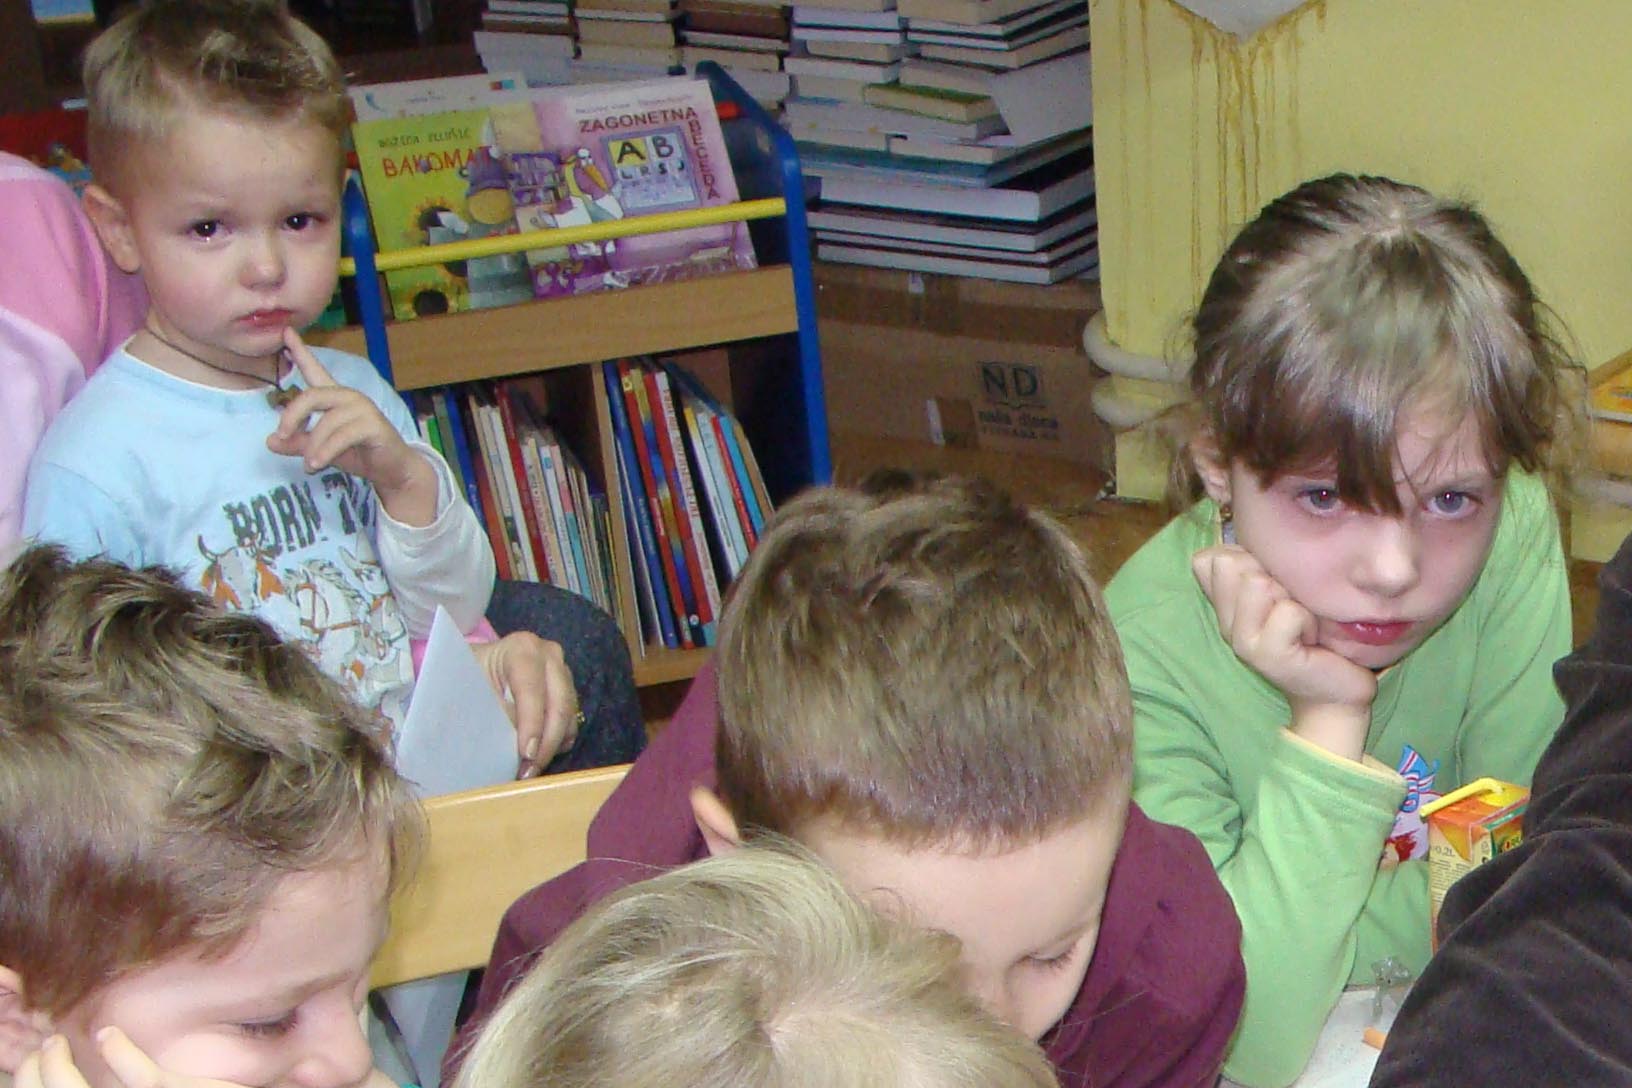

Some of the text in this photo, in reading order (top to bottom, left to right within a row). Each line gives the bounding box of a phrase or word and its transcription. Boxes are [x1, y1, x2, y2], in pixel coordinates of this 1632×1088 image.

[579, 107, 698, 133] ZAGONETNA
[617, 136, 674, 164] A B
[982, 366, 1038, 399] ND
